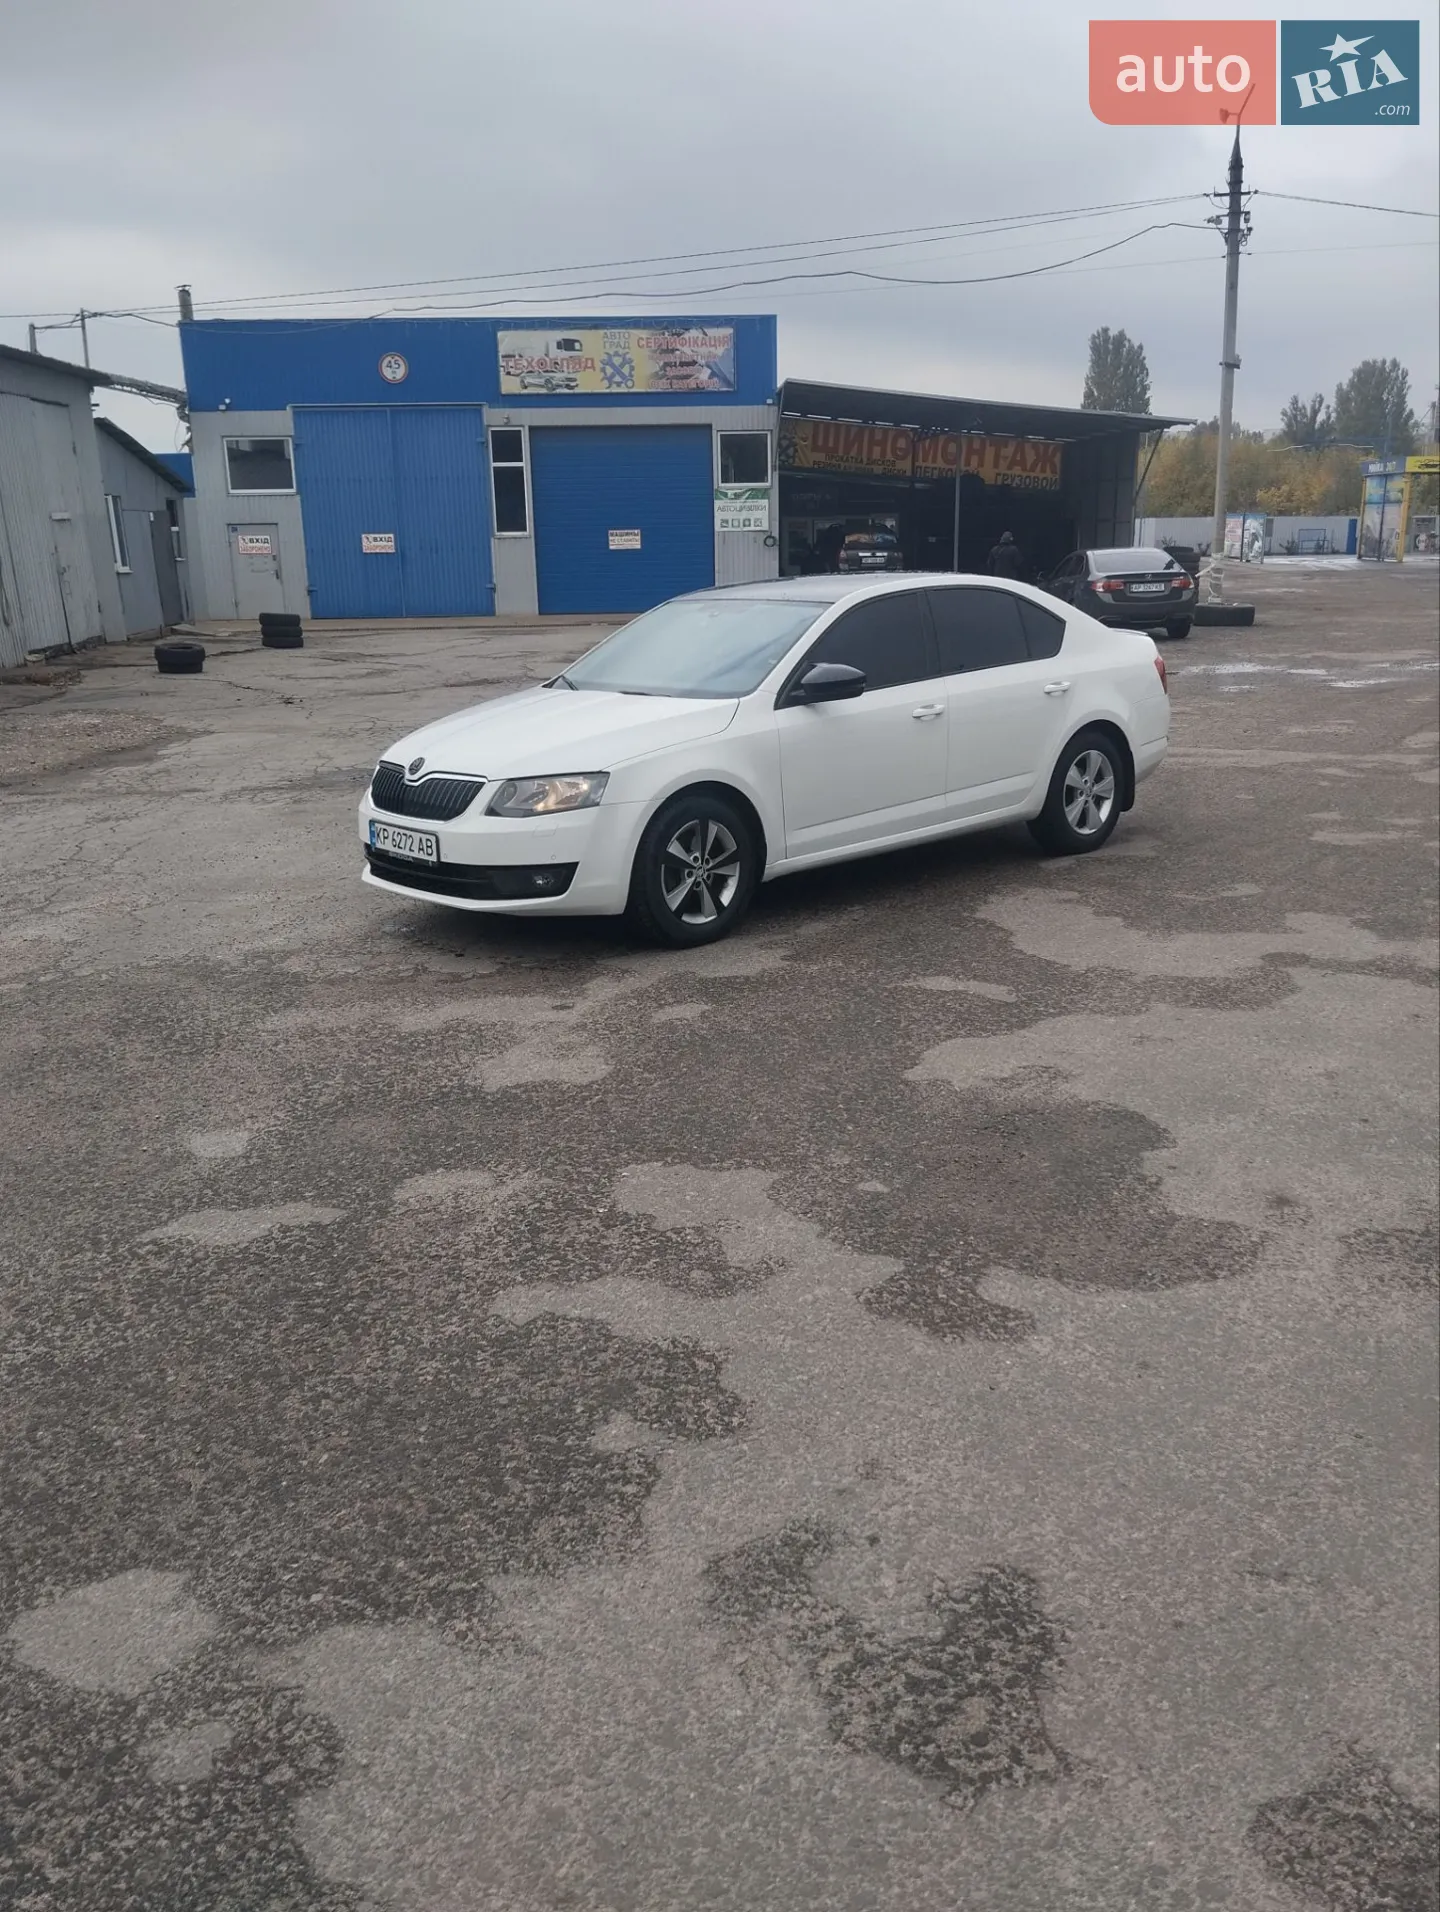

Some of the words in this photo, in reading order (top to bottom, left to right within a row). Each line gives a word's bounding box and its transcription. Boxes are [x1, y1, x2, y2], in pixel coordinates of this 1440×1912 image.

[602, 331, 630, 341] АВТО
[602, 340, 631, 350] ГРАД
[502, 356, 596, 372] ТЕХОГЛЯД
[249, 537, 270, 545] ВХІД
[375, 826, 389, 845] KP
[391, 830, 415, 852] 6272
[417, 836, 434, 857] AB
